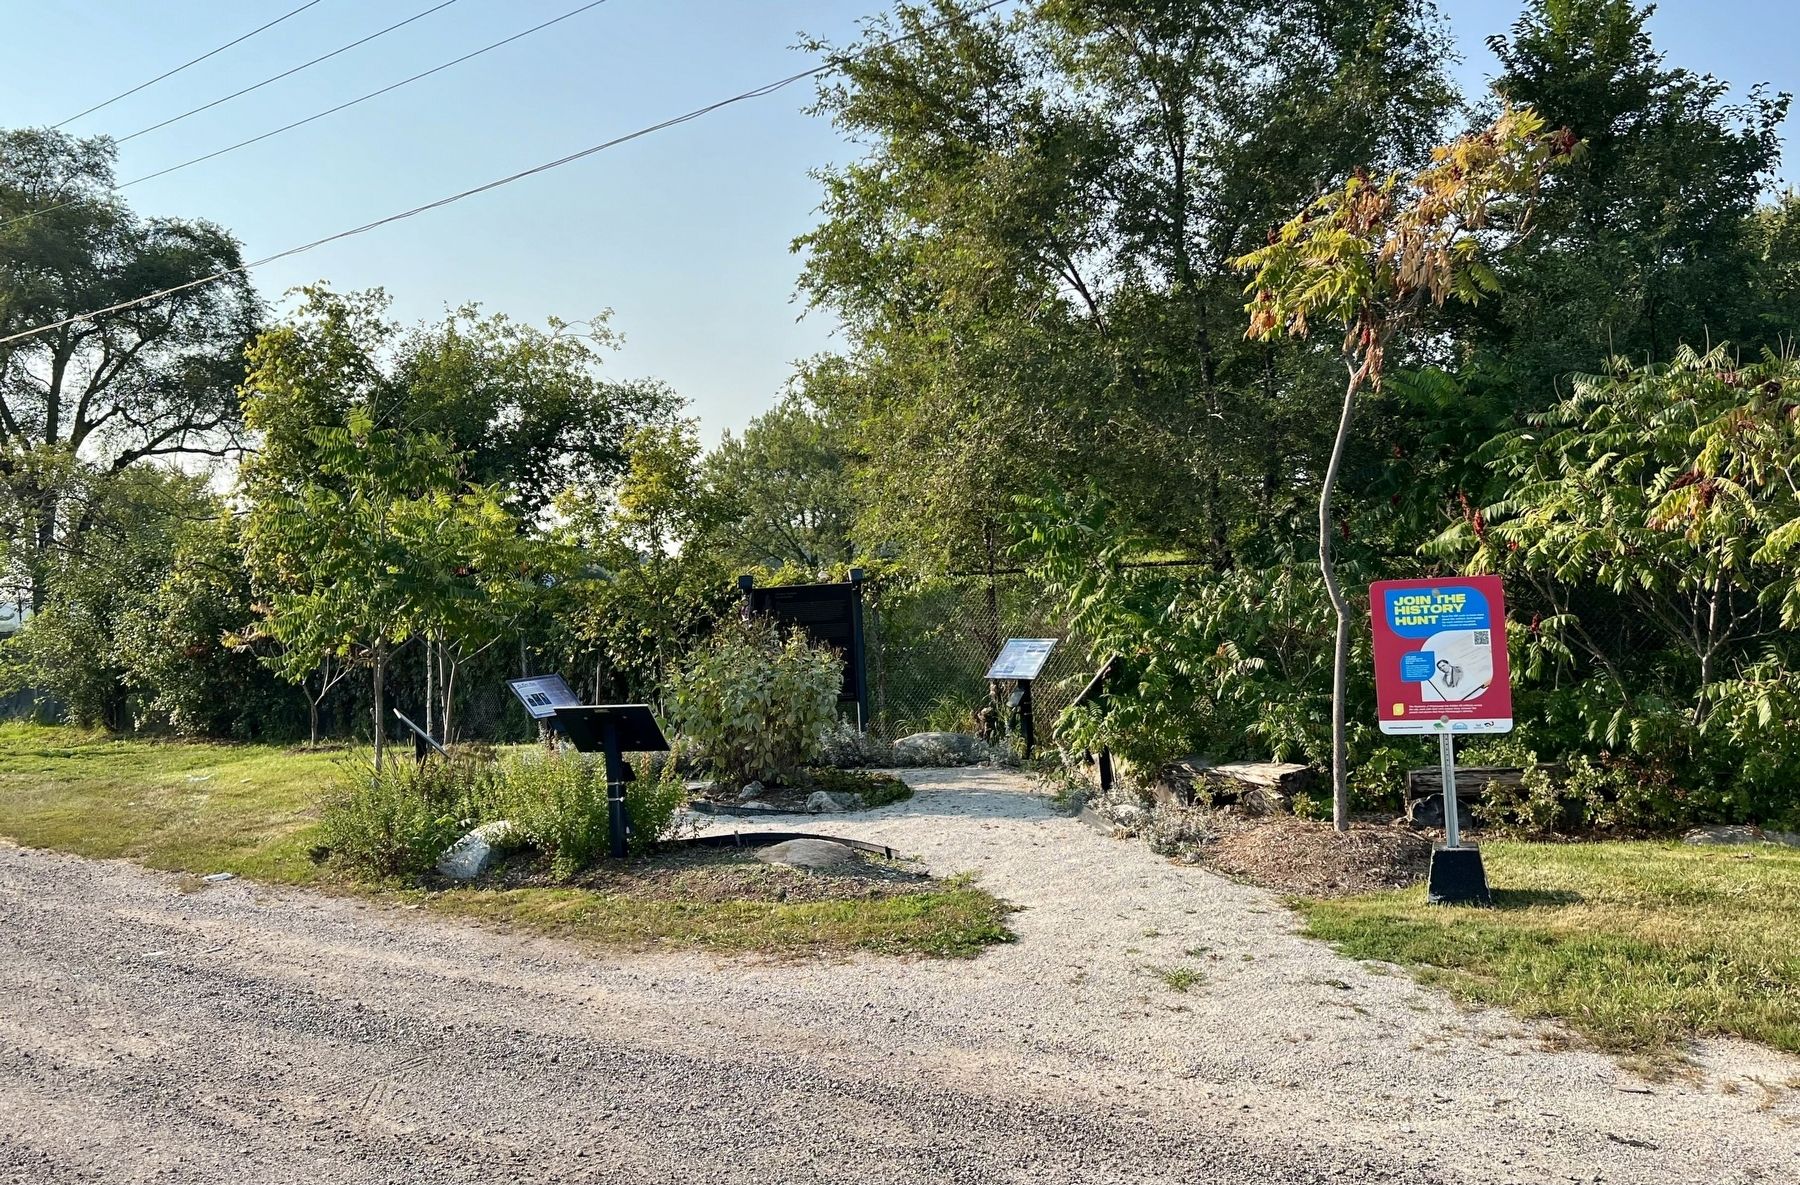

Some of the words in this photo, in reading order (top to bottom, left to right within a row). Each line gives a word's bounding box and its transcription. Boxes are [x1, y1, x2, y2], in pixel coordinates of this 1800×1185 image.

[1394, 596, 1431, 606] JOIN
[1436, 594, 1466, 604] THE
[1394, 603, 1464, 615] HISTORY
[1395, 615, 1439, 626] HUNT
